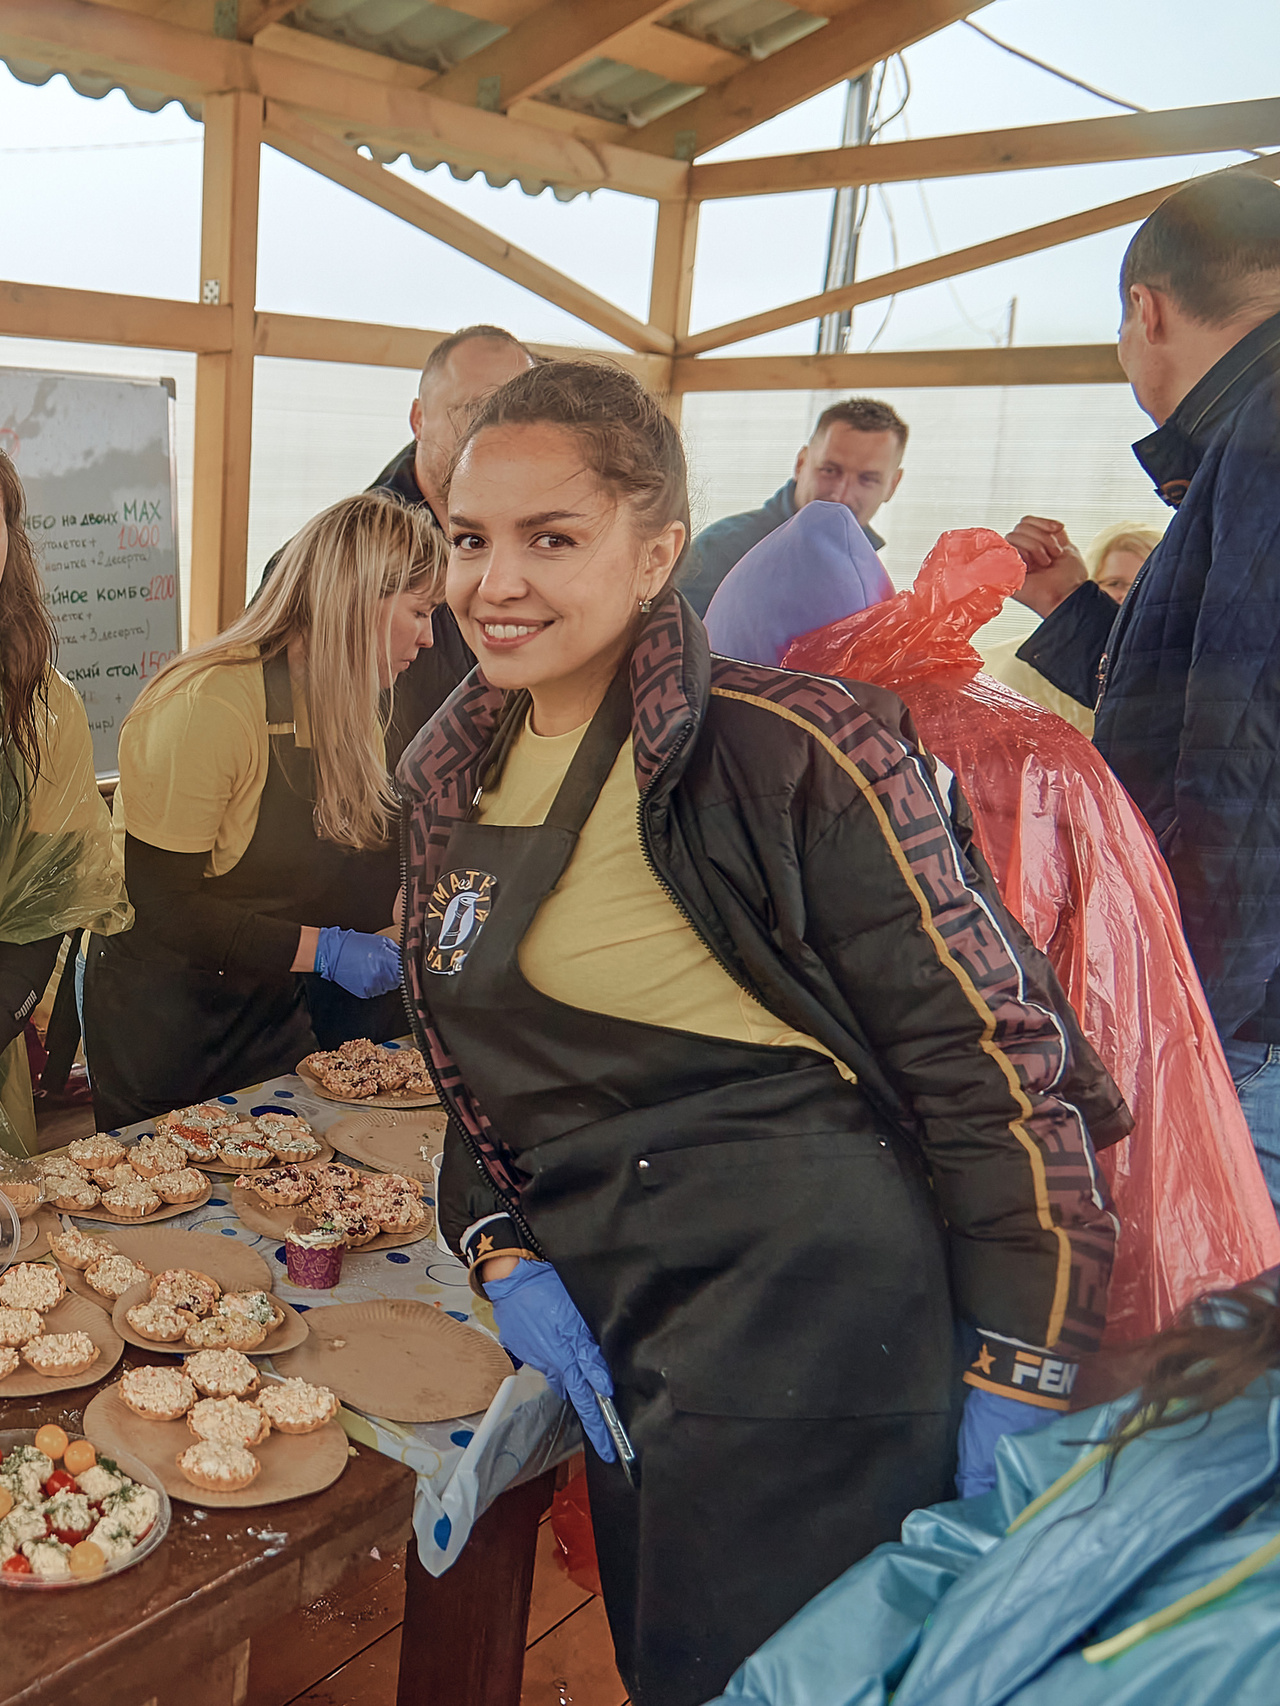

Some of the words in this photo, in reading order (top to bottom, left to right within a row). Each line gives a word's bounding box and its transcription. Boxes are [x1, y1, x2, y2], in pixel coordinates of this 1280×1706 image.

[118, 524, 160, 550] 1000
[42, 585, 88, 606] ейное
[144, 574, 175, 602] 1200
[66, 661, 100, 681] ский
